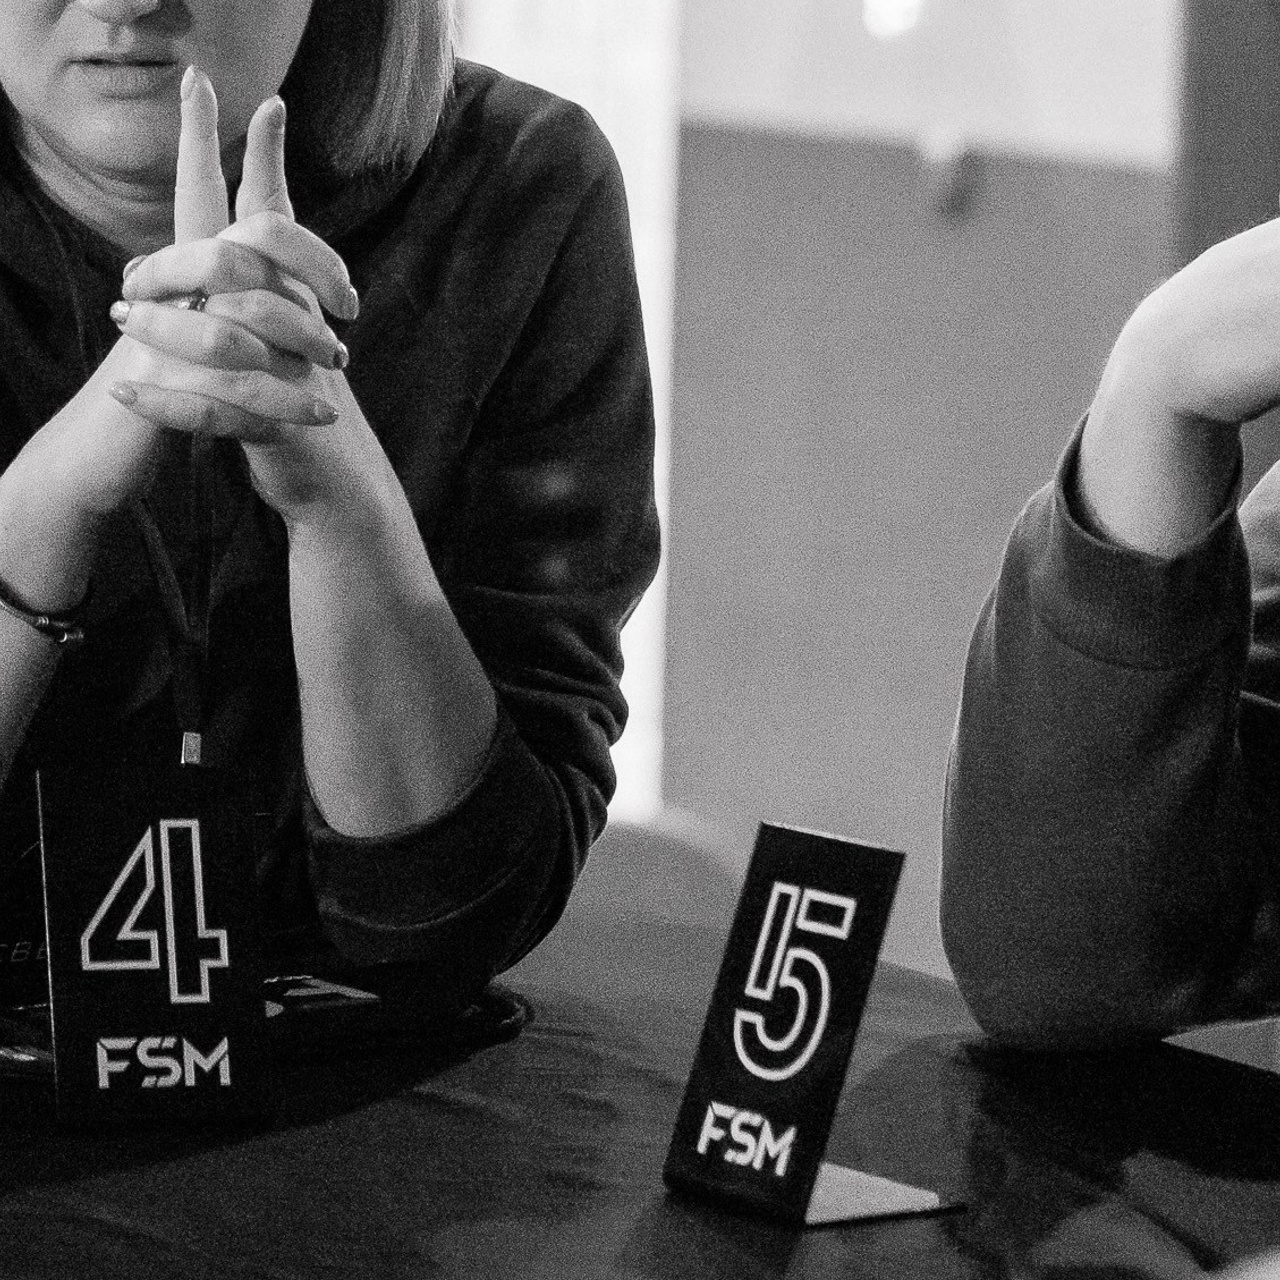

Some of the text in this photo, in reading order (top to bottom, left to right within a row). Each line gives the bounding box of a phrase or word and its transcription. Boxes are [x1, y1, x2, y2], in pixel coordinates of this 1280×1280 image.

[80, 818, 230, 1004] 4
[733, 881, 857, 1081] 5
[96, 1037, 231, 1089] FSM
[696, 1101, 797, 1177] FSM
